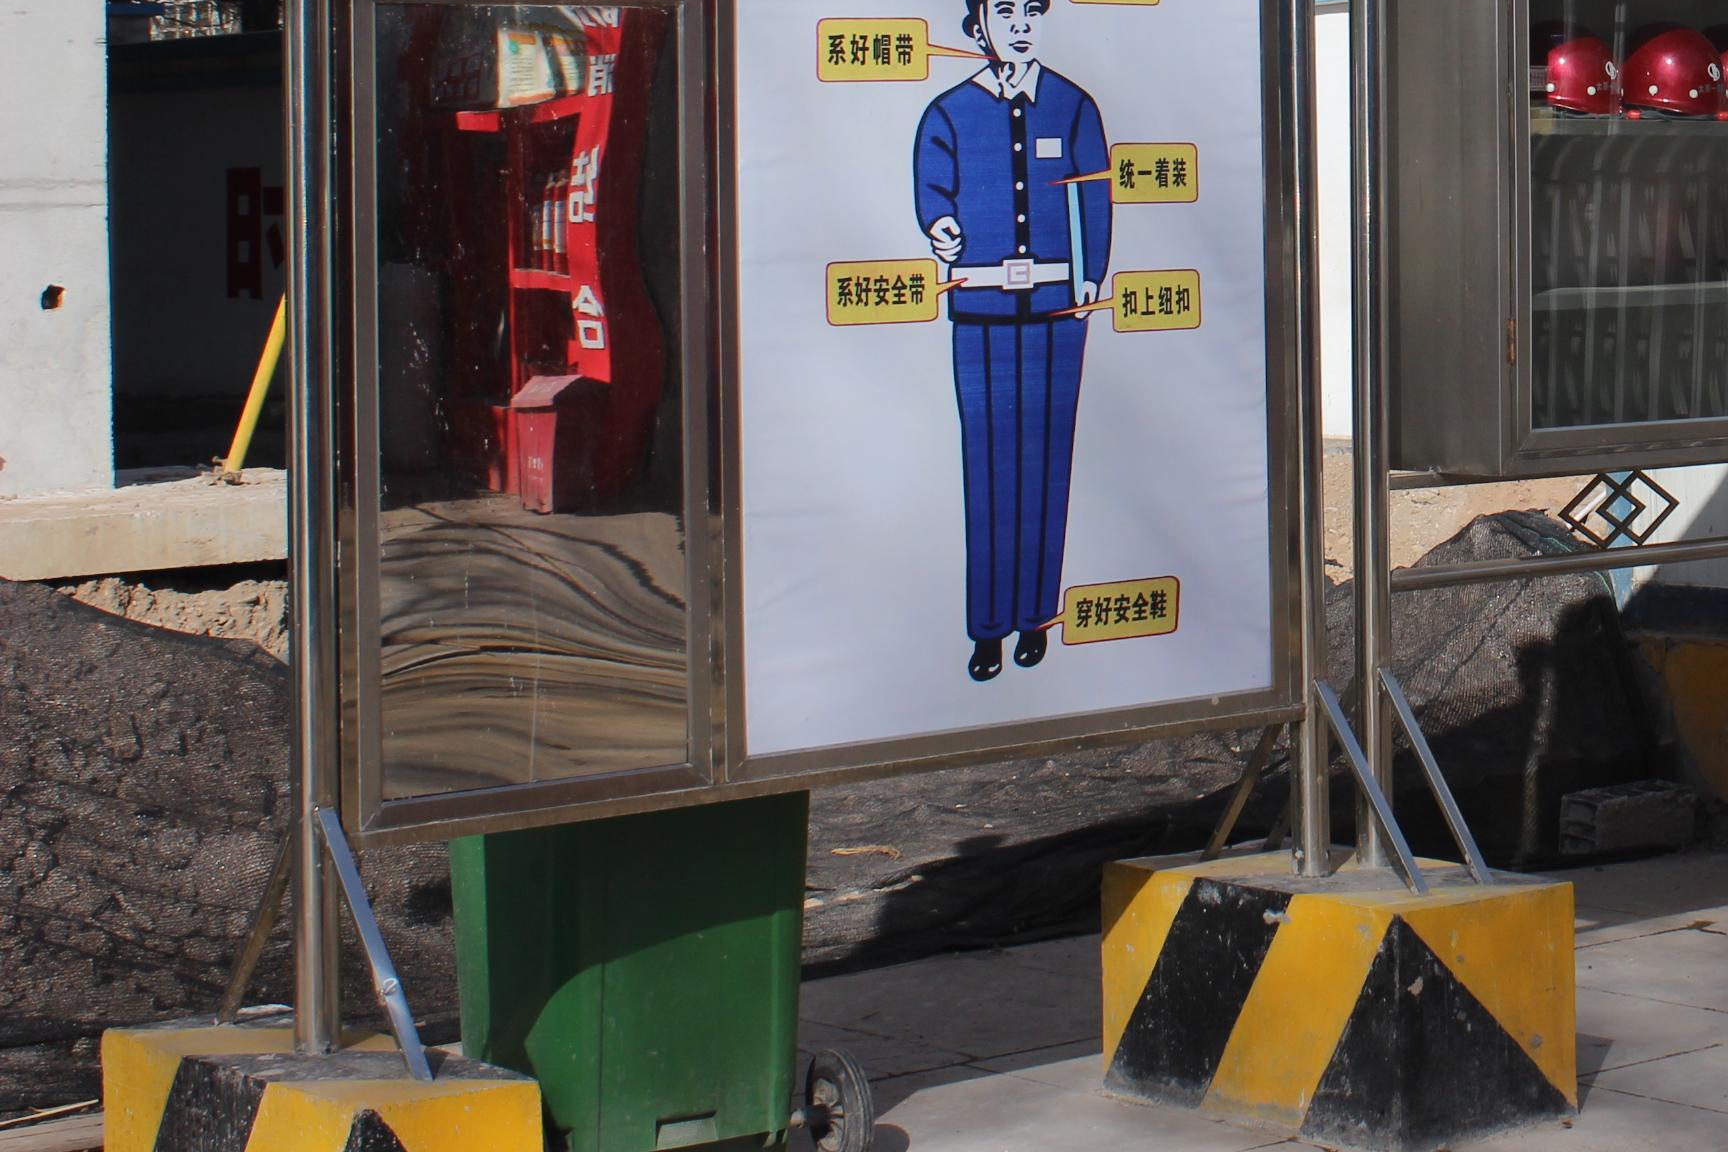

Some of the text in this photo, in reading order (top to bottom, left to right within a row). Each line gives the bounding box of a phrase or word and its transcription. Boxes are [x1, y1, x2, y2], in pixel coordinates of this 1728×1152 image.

[828, 33, 914, 66] 系好帽带
[1119, 157, 1187, 189] 统一着装
[836, 273, 925, 307] 系好安全带
[1122, 284, 1191, 318] 扣上纽扣
[1076, 589, 1168, 628] 穿好安全鞋
